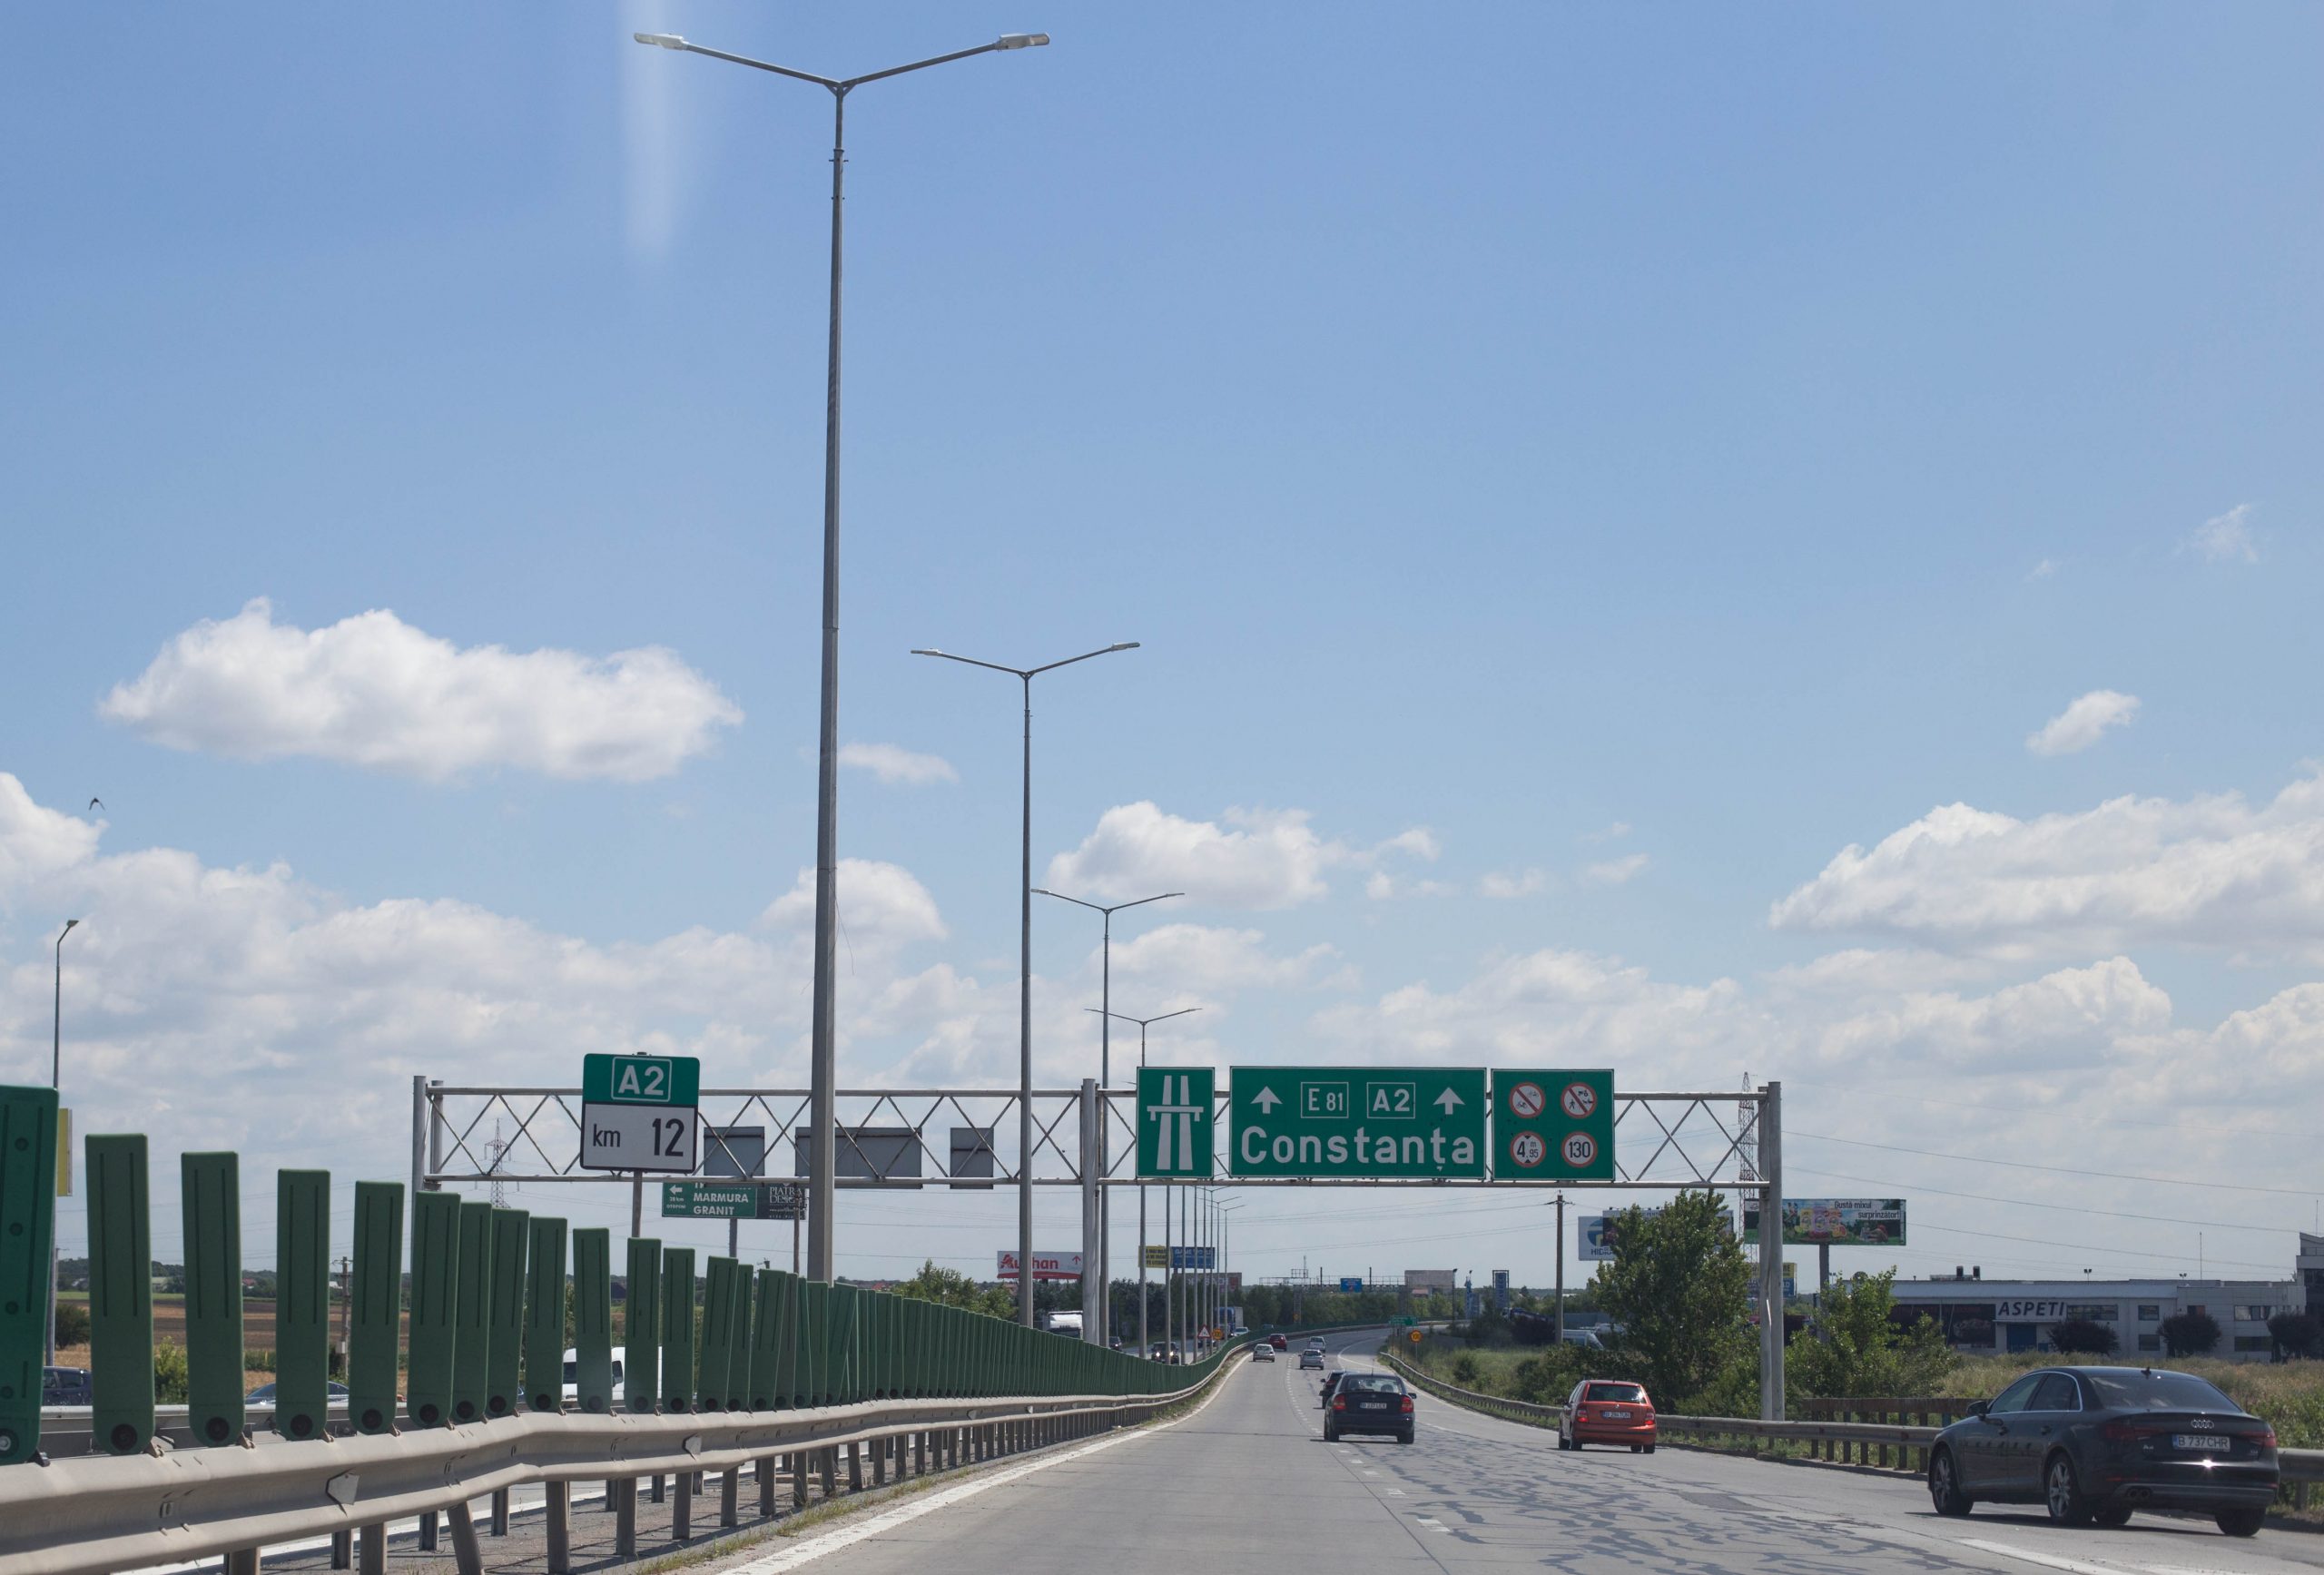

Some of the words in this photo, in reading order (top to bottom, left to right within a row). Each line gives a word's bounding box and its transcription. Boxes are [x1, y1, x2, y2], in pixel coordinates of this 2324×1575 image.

[617, 1064, 665, 1097] A2
[1308, 1088, 1320, 1111] E
[1325, 1091, 1344, 1112] 81
[1372, 1088, 1411, 1112] A2
[592, 1123, 621, 1148] km
[651, 1117, 685, 1157] 12
[1241, 1125, 1475, 1172] Constanța
[1568, 1140, 1591, 1158] 130
[693, 1192, 749, 1204] MARMURA
[693, 1205, 735, 1216] GRANIT
[1000, 1254, 1059, 1270] Auhan
[1998, 1301, 2065, 1316] ASPETI
[2178, 1437, 2186, 1446] B
[2189, 1437, 2206, 1447] 737
[2207, 1437, 2229, 1448] CHR
